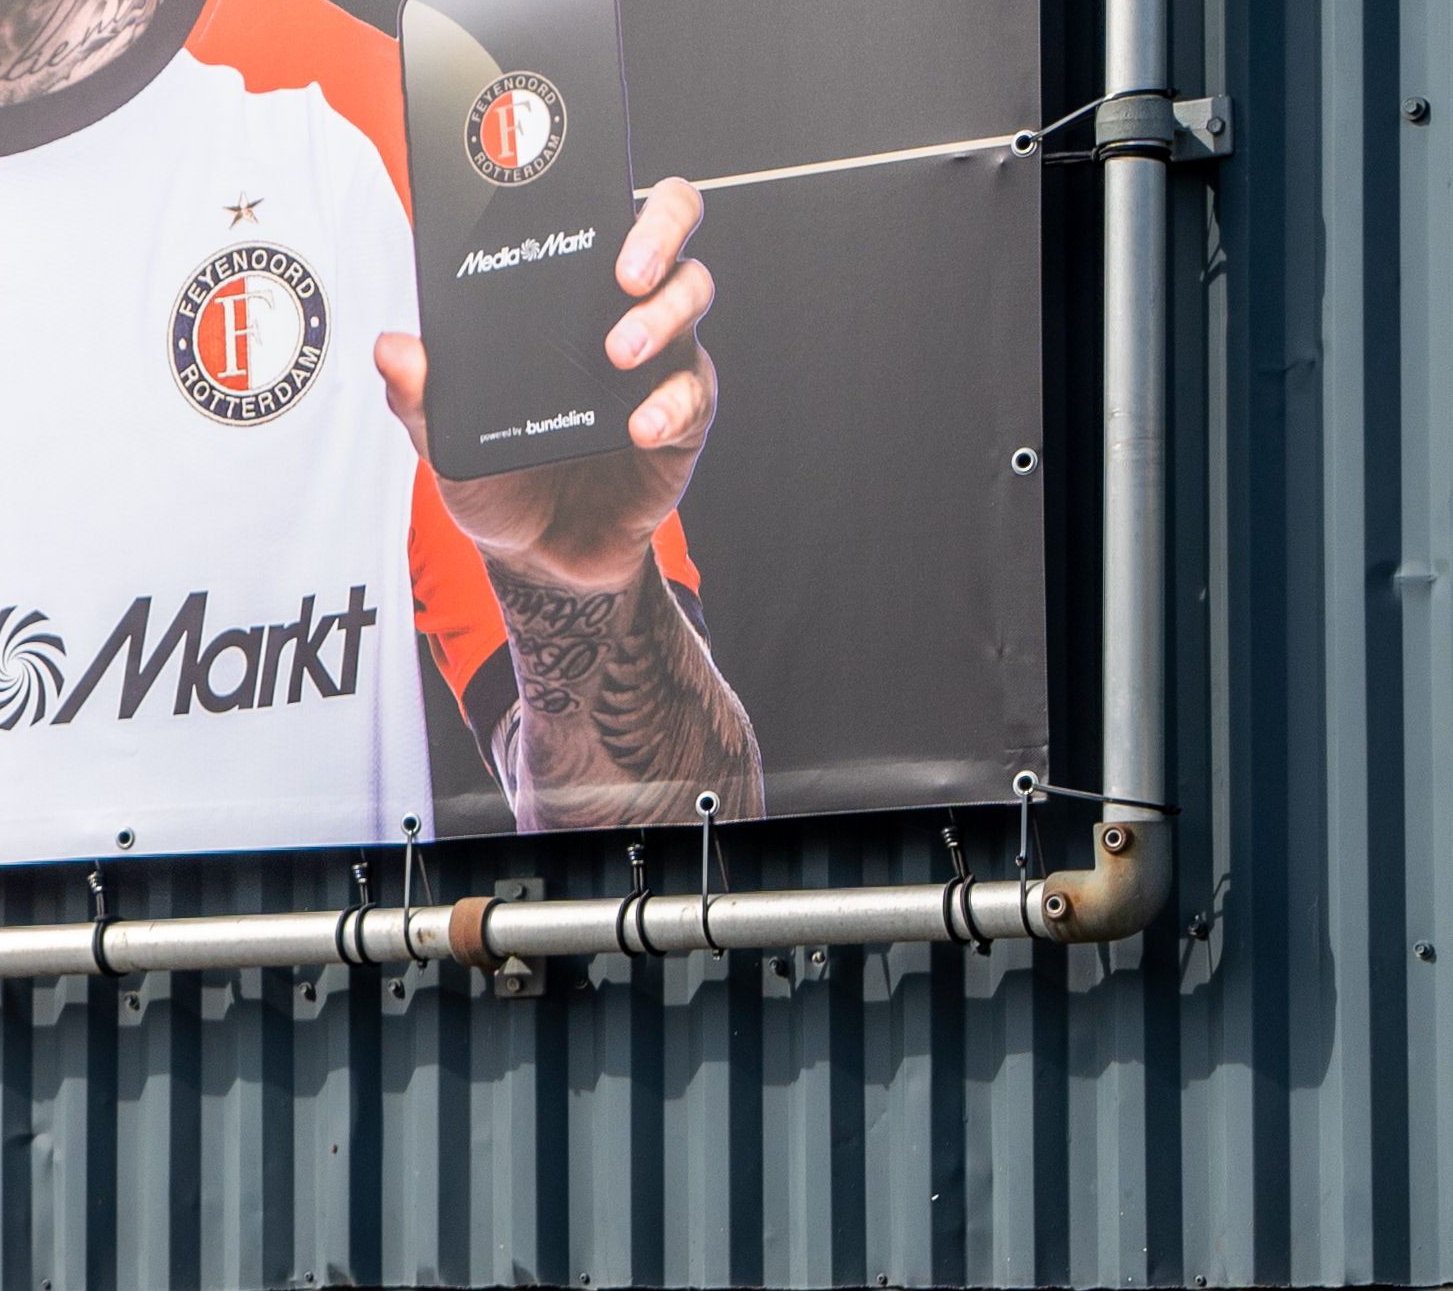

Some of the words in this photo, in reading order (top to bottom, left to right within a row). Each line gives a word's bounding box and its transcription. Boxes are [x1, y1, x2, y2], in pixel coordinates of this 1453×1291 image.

[471, 75, 557, 123] FEYENOORD
[473, 133, 561, 182] ROTTERDAM
[178, 249, 317, 319] FEYENOORD
[178, 344, 322, 419] ROTTERDAM
[479, 427, 512, 445] powered
[525, 409, 596, 436] bundeling
